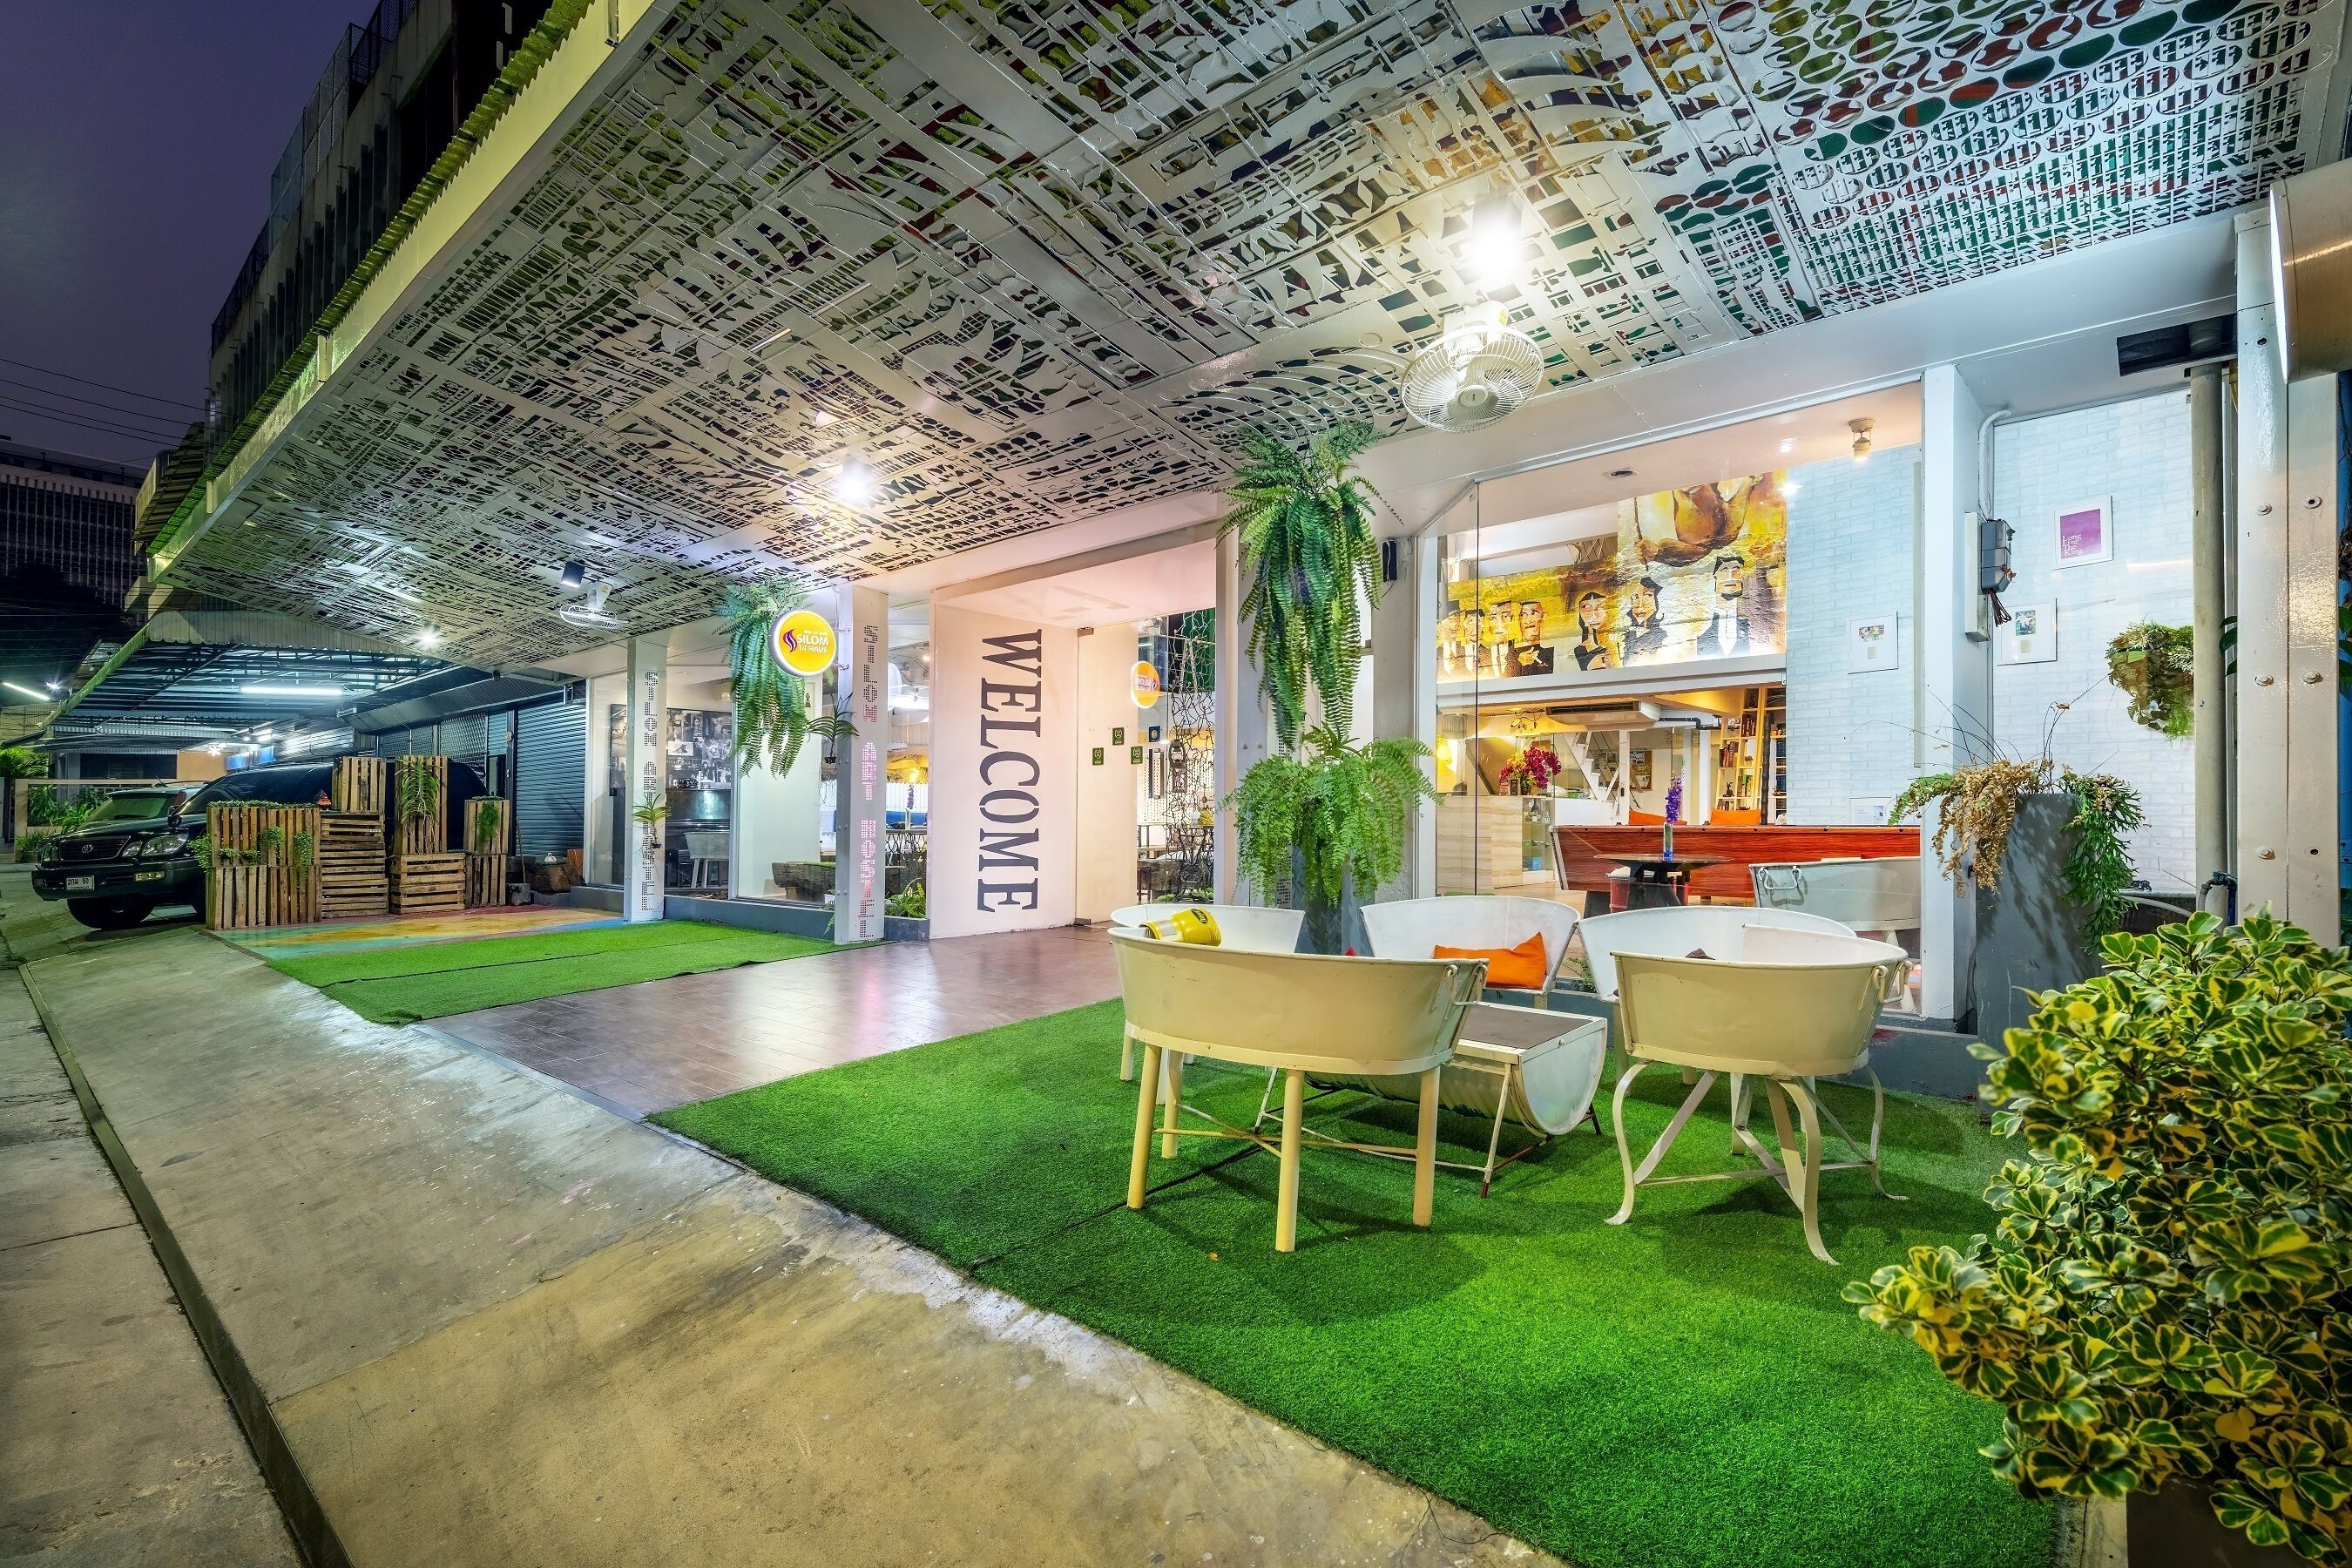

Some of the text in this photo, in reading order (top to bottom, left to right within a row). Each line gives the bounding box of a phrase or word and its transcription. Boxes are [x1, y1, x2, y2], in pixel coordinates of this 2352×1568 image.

[641, 672, 658, 911] SILOM ART HOSTEL
[859, 625, 878, 938] SILOM ART HOSTEL
[977, 628, 1043, 914] WELCOME
